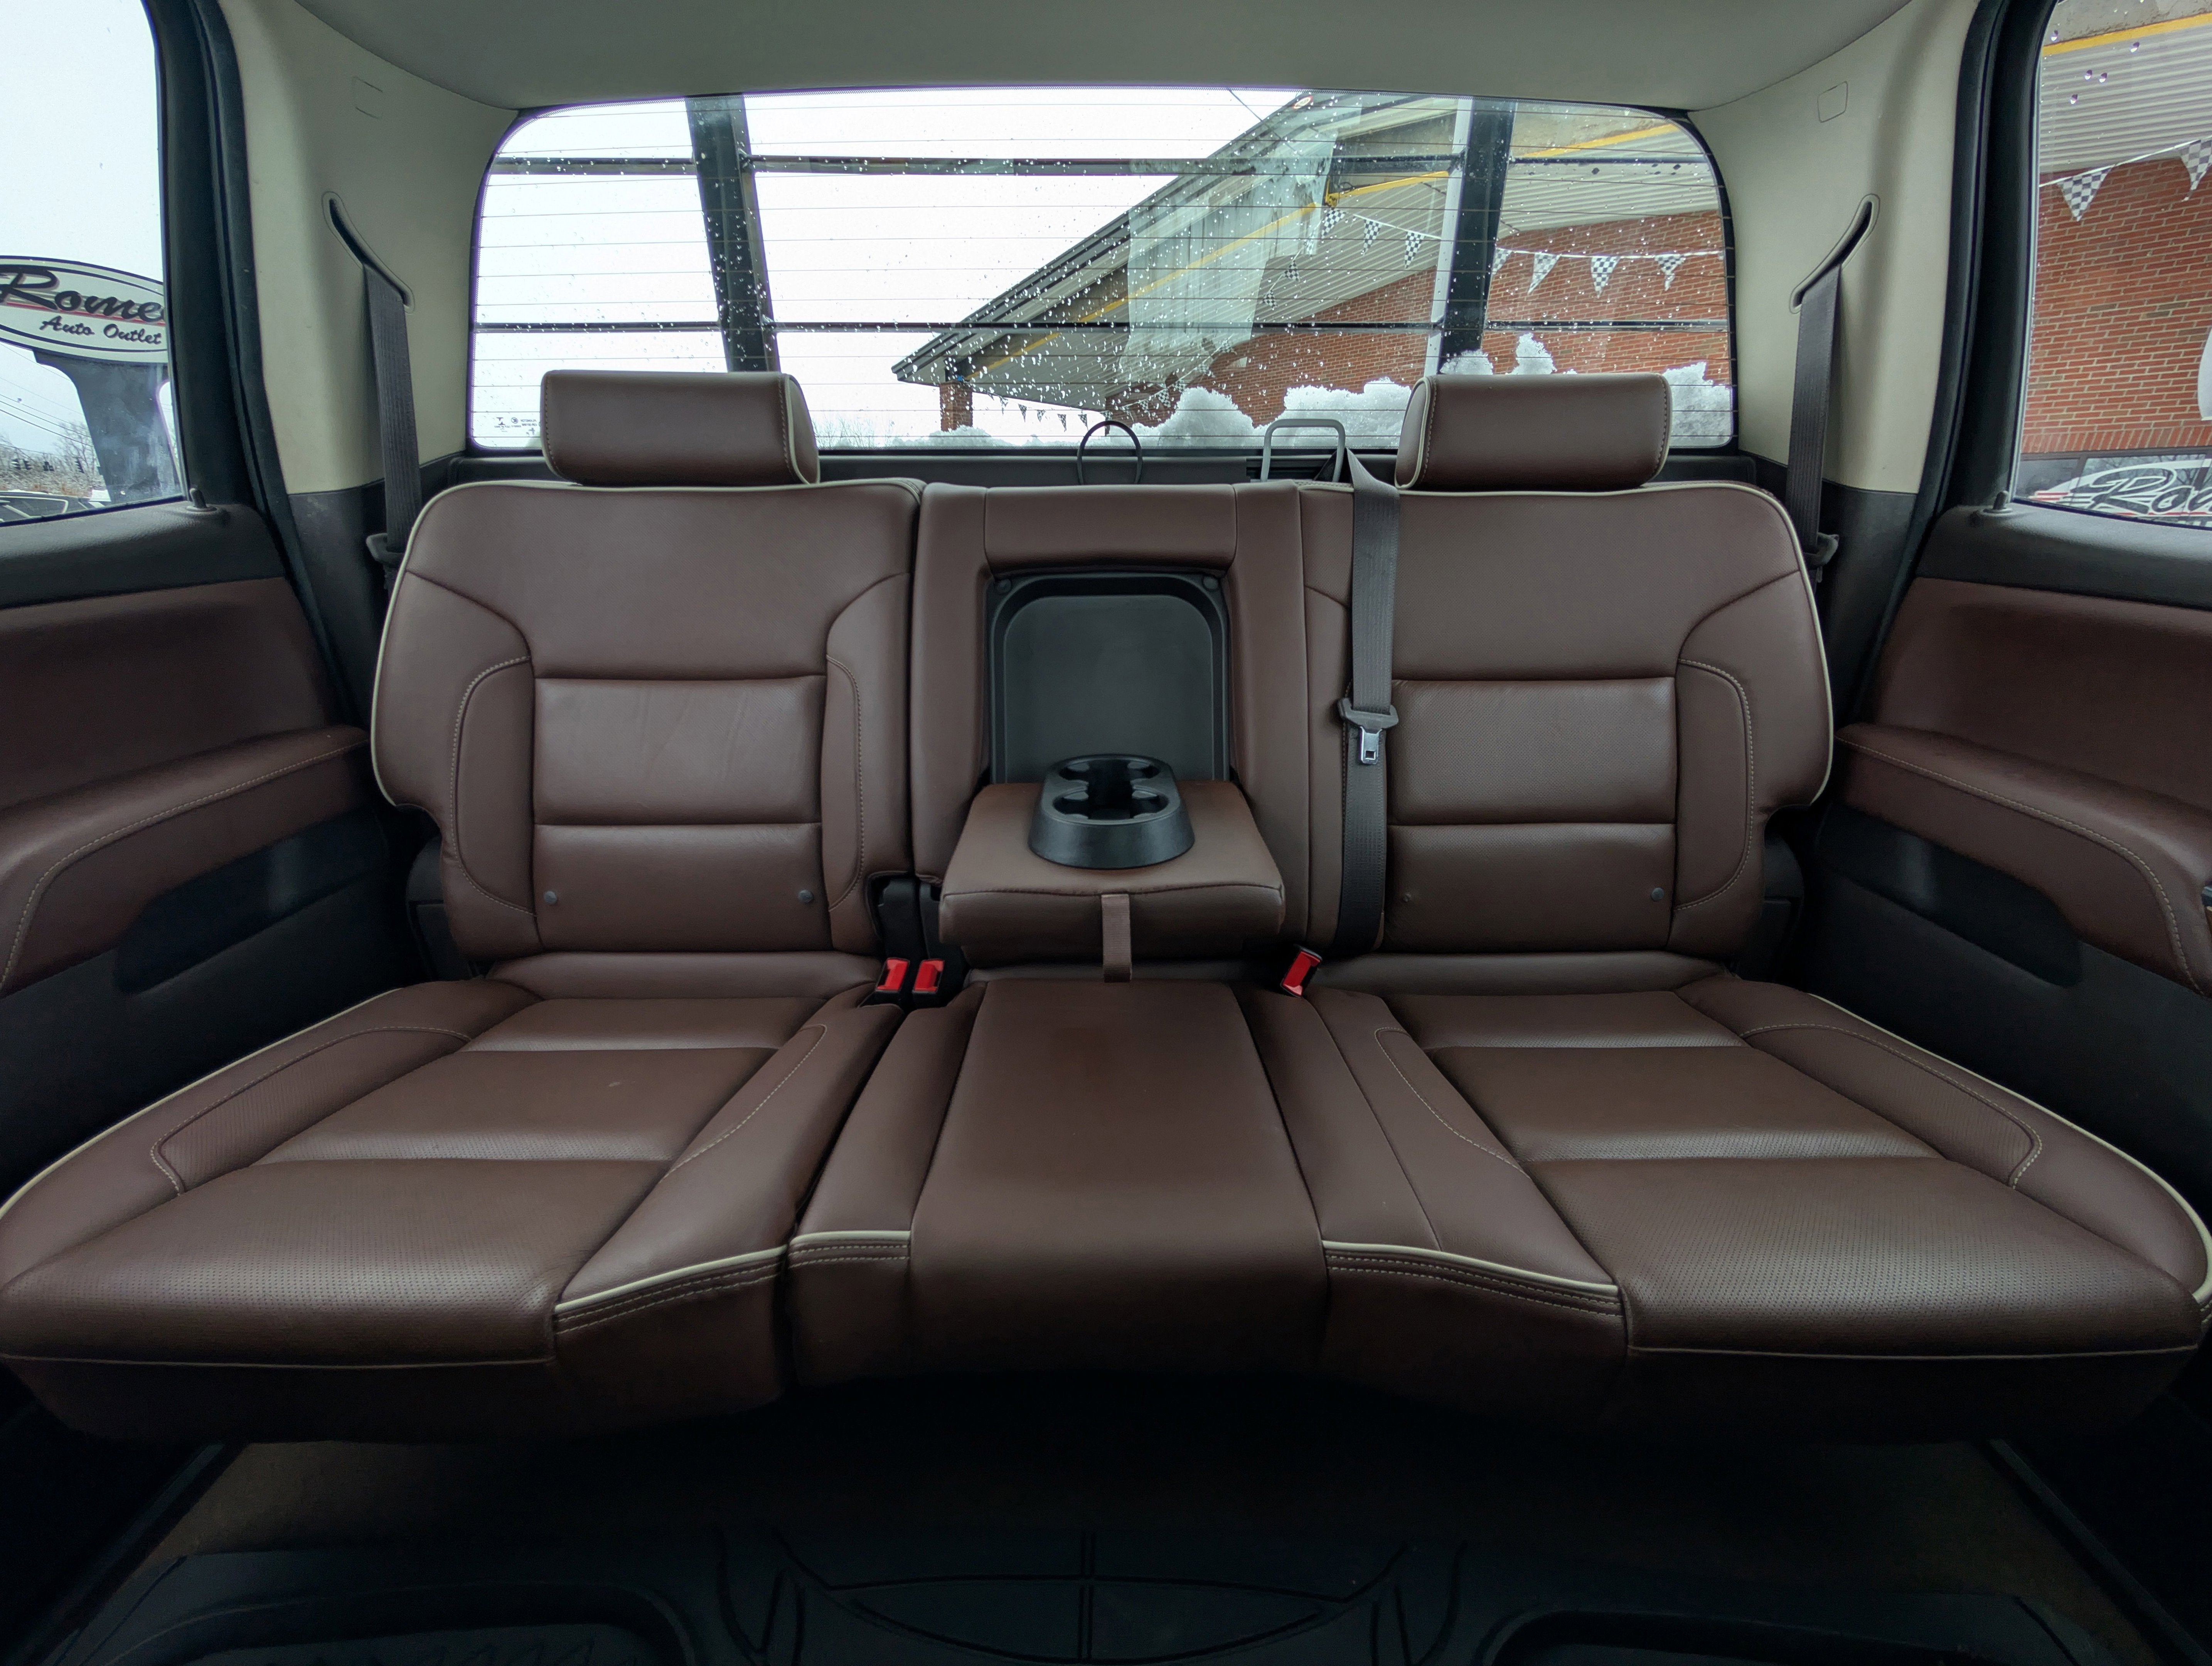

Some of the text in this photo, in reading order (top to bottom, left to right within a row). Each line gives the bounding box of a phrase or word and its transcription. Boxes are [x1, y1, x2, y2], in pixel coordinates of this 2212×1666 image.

[0, 265, 165, 322] Rome
[39, 315, 162, 344] Auto Outlet
